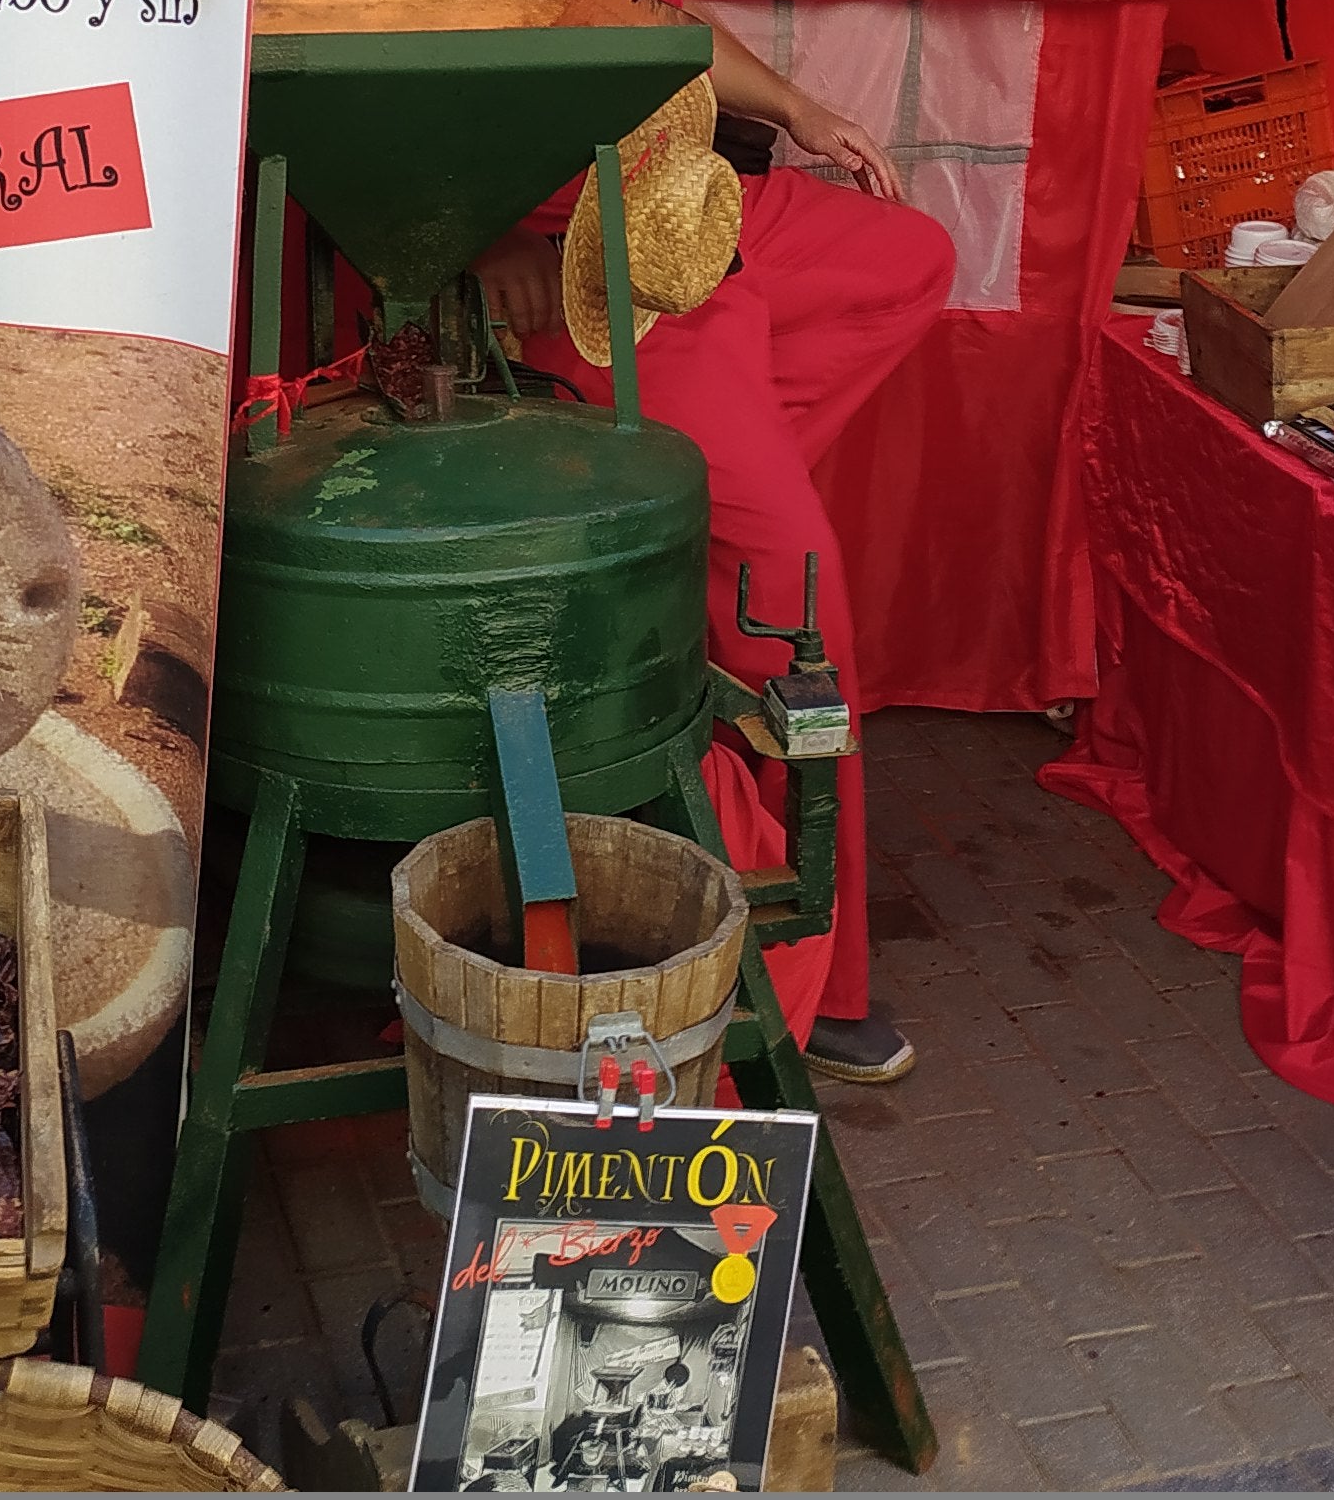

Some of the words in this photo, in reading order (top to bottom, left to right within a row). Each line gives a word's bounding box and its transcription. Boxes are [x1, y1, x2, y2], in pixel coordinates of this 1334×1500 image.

[499, 1118, 779, 1216] PIMENTÓN
[451, 1228, 519, 1292] del
[546, 1220, 664, 1267] Bierzo
[597, 1274, 688, 1294] MOLINO
